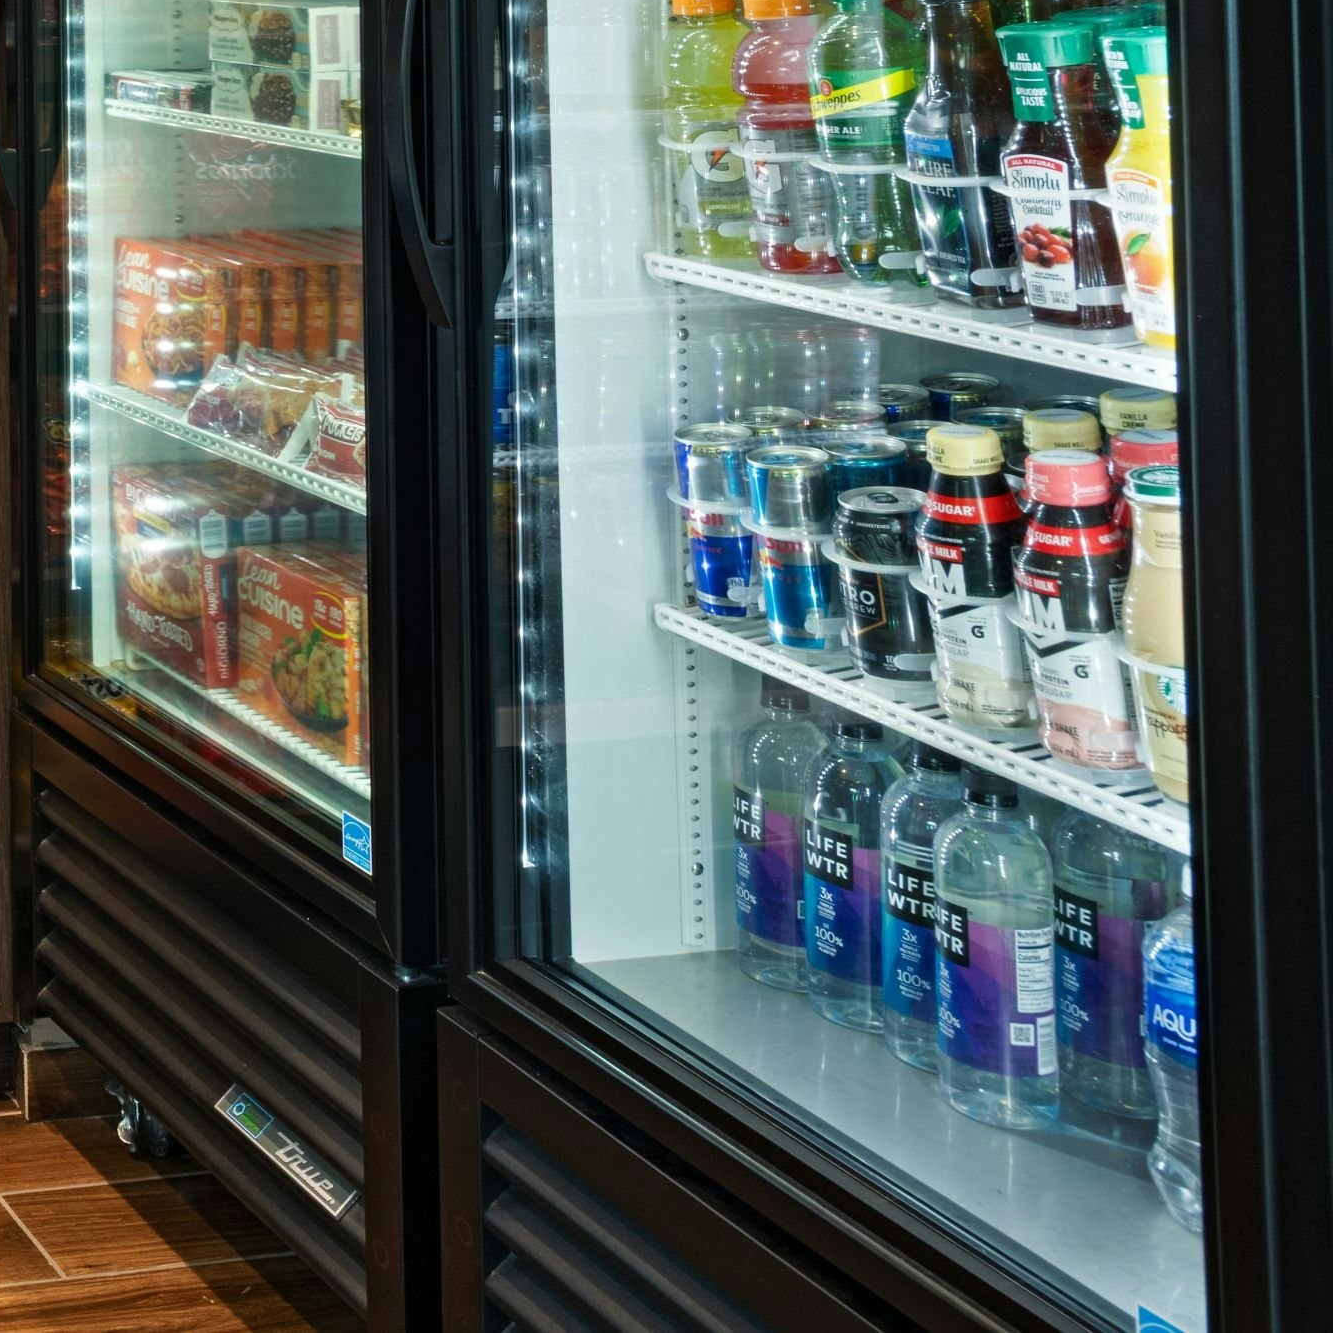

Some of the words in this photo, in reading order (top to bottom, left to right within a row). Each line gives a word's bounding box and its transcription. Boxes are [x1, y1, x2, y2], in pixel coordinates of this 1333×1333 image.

[1021, 95, 1045, 107] TASTE
[853, 604, 876, 615] BREW
[807, 830, 848, 858] LIFE
[806, 850, 848, 880] WTR
[888, 869, 935, 897] LIFE
